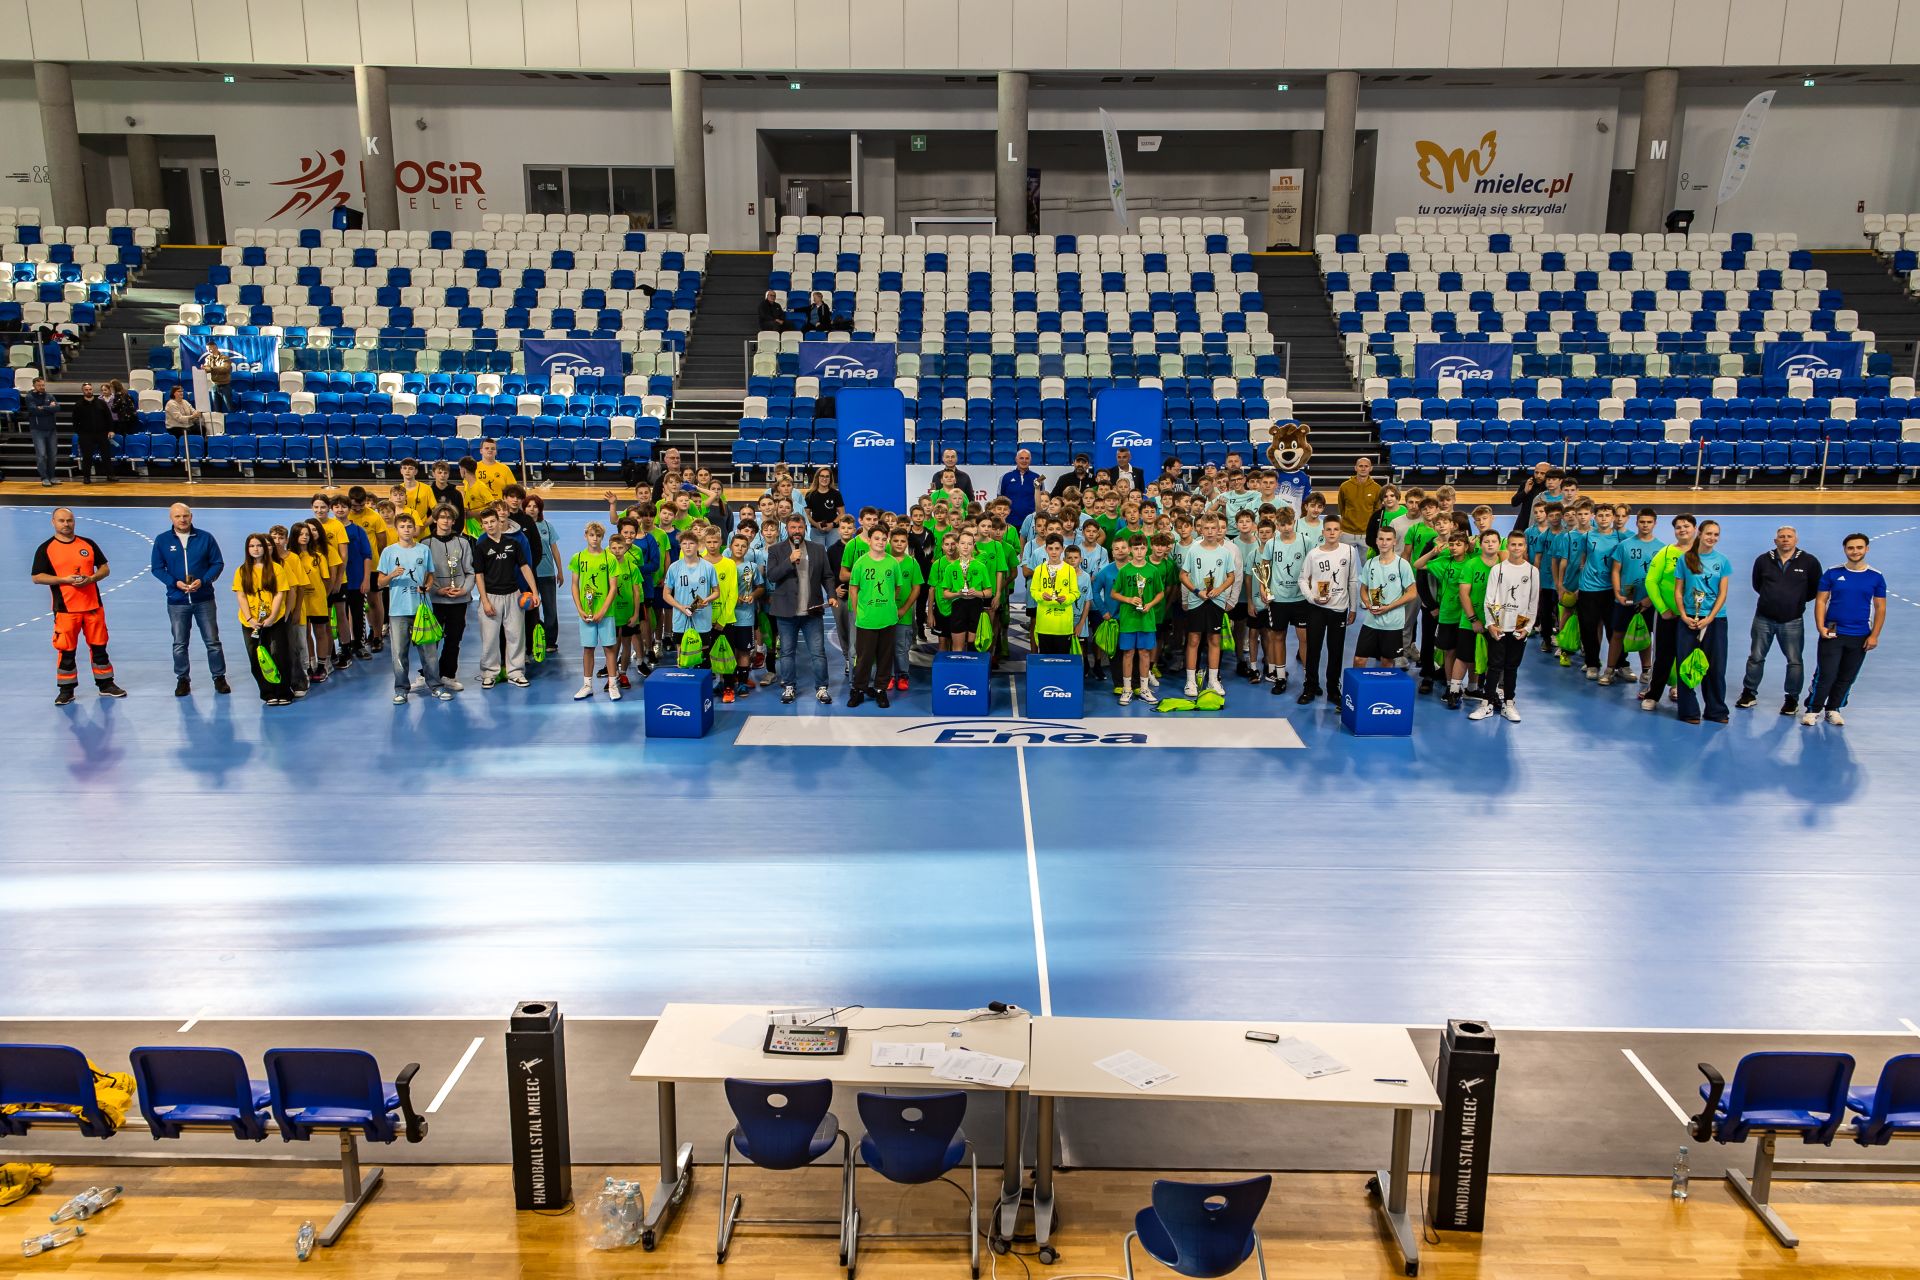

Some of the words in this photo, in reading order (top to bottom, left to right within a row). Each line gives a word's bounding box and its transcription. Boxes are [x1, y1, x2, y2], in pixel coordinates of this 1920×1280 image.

[366, 137, 380, 155] K
[1008, 142, 1018, 161] L
[1650, 140, 1667, 160] M
[360, 160, 485, 194] OSiR
[1474, 173, 1574, 198] mielec.pl
[363, 197, 488, 210] ELEC
[1418, 204, 1430, 215] tu
[1434, 204, 1487, 216] rozwijają
[1490, 204, 1508, 216] się
[1511, 203, 1567, 216] skrzydła!
[231, 361, 263, 373] nea
[551, 362, 605, 377] Enea
[823, 365, 879, 379] Enea
[1438, 366, 1494, 380] Enea
[1786, 364, 1842, 380] Enea
[853, 436, 895, 447] Enea
[1111, 436, 1153, 447] Enea
[478, 471, 487, 480] 35
[1274, 551, 1283, 562] 18
[1630, 548, 1642, 559] 33
[580, 561, 588, 572] 21
[1196, 557, 1202, 569] 9
[1318, 560, 1331, 572] 99
[680, 575, 689, 586] 10
[865, 568, 876, 580] 22
[1474, 572, 1486, 583] 24
[948, 687, 977, 696] Enea
[1043, 690, 1072, 698] Enea
[661, 708, 691, 717] Enea
[1371, 707, 1402, 715] Enea
[934, 728, 1148, 744] Enea
[526, 1077, 541, 1115] MIELEC
[1461, 1097, 1478, 1136] MIELEC
[528, 1118, 543, 1145] STAL
[1458, 1138, 1475, 1165] STAL
[530, 1147, 547, 1205] HANDBALL
[1454, 1168, 1472, 1226] HANDBALL
